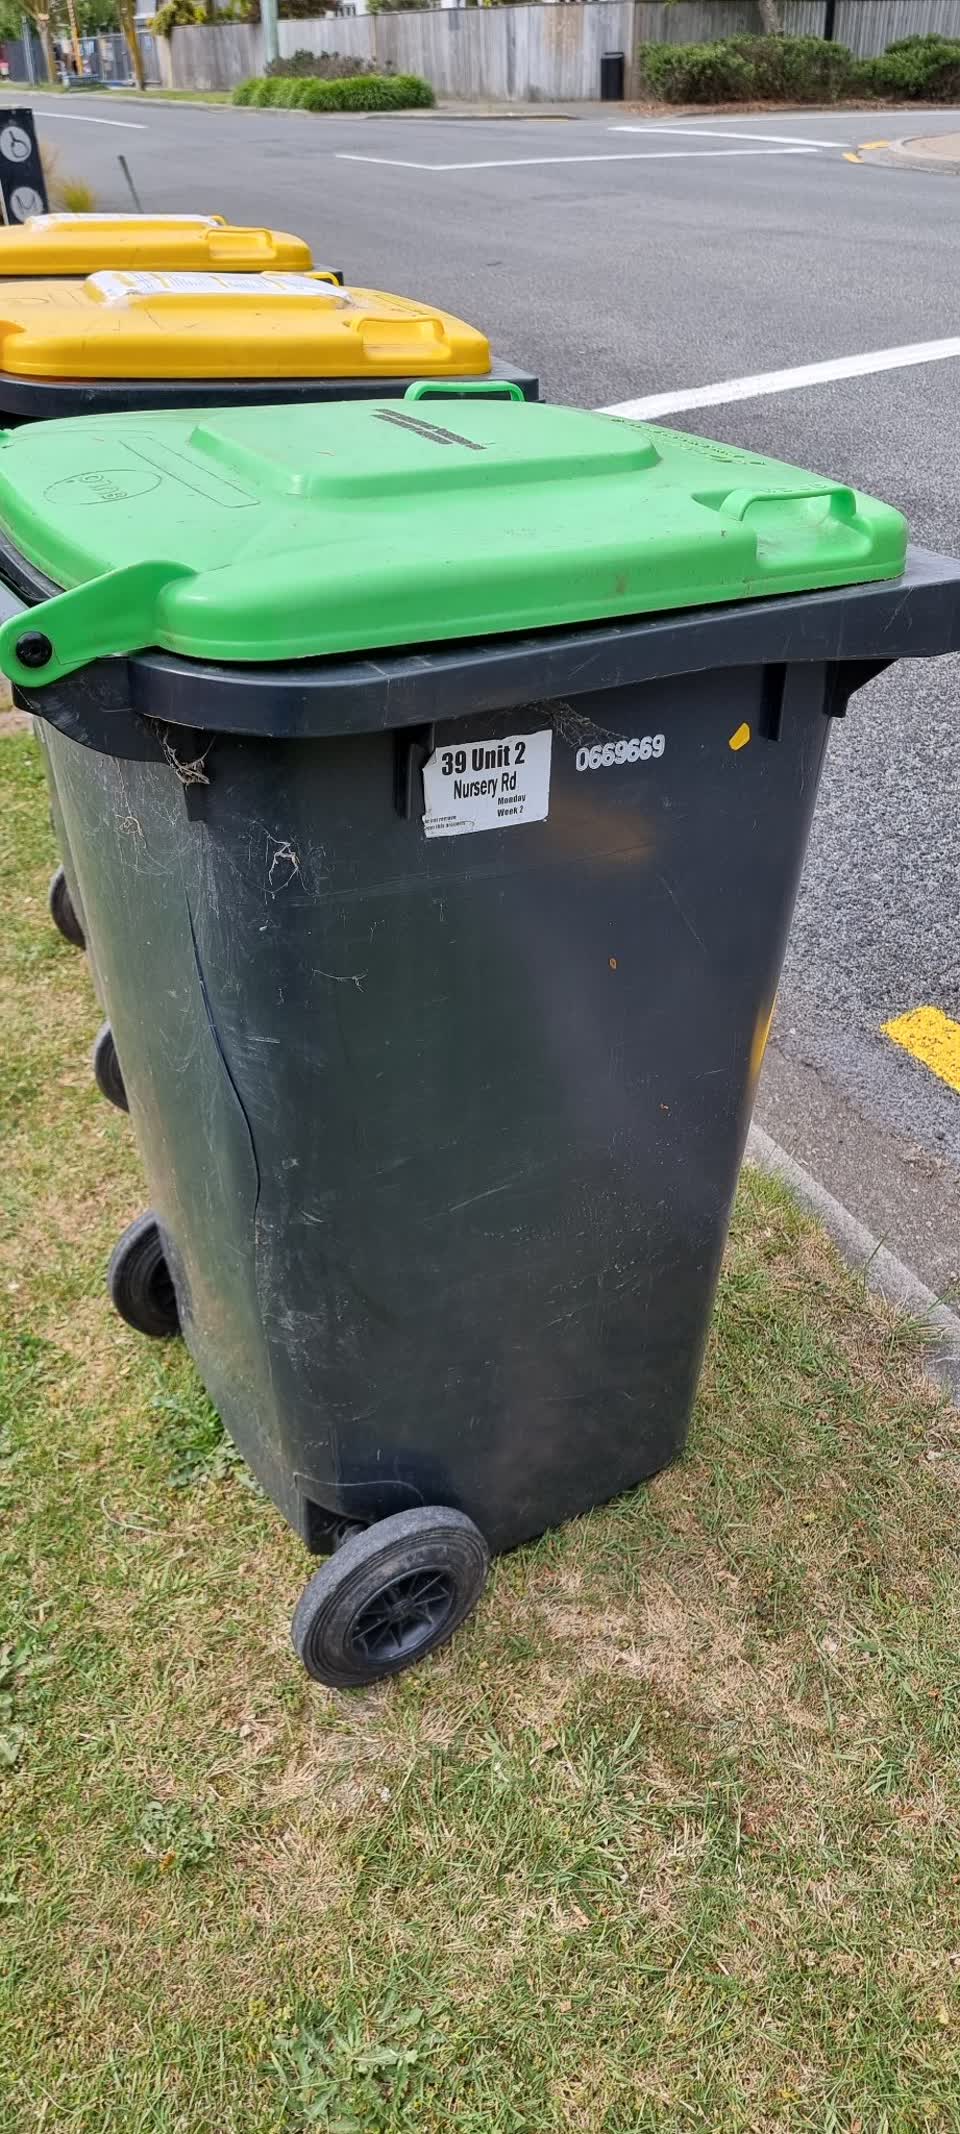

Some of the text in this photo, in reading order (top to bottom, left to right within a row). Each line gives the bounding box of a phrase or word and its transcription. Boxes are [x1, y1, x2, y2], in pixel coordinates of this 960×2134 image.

[441, 741, 526, 776] 39 Unit 2
[575, 734, 666, 772] 0669669
[453, 770, 517, 800] Nursery Rd
[497, 794, 526, 806] Monday
[497, 805, 524, 817] Week 2
